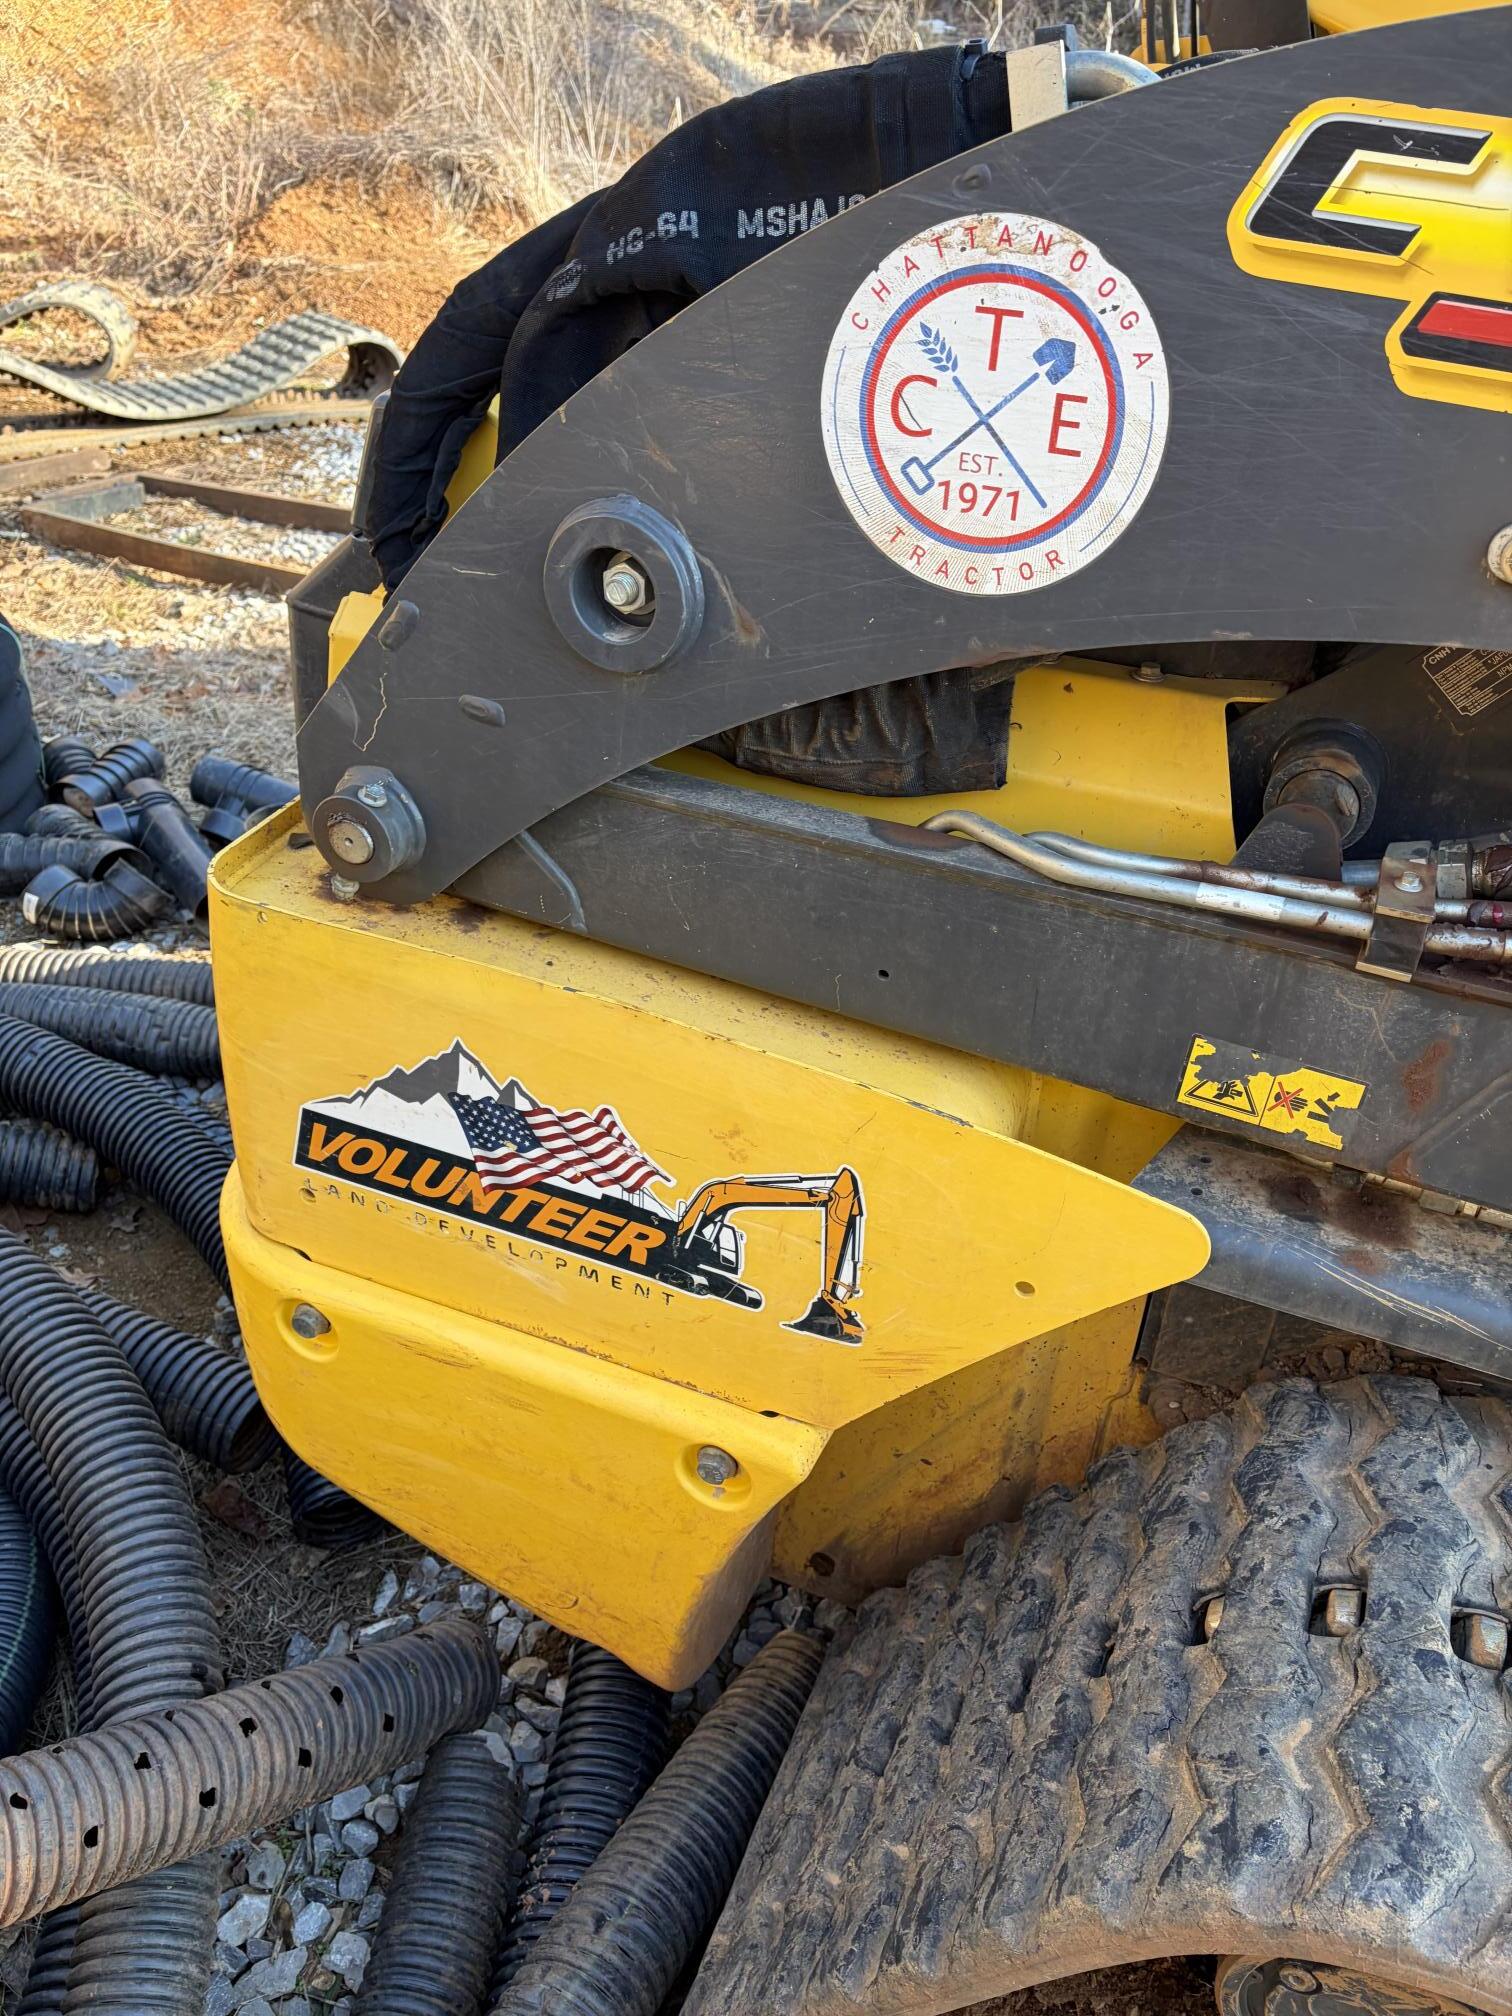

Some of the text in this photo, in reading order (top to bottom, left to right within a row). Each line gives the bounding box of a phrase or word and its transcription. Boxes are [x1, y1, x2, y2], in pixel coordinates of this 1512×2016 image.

[606, 209, 700, 264] HG-64
[736, 198, 828, 240] MSHA
[851, 224, 1154, 370] CHATTANOOGA
[958, 452, 1003, 477] EST.
[937, 480, 1020, 521] 1971
[888, 526, 1066, 586] TRACTOR
[1429, 647, 1451, 665] CNH
[307, 1122, 667, 1266] VOLUNTEER
[415, 1211, 675, 1306] DEVELOPMENT
